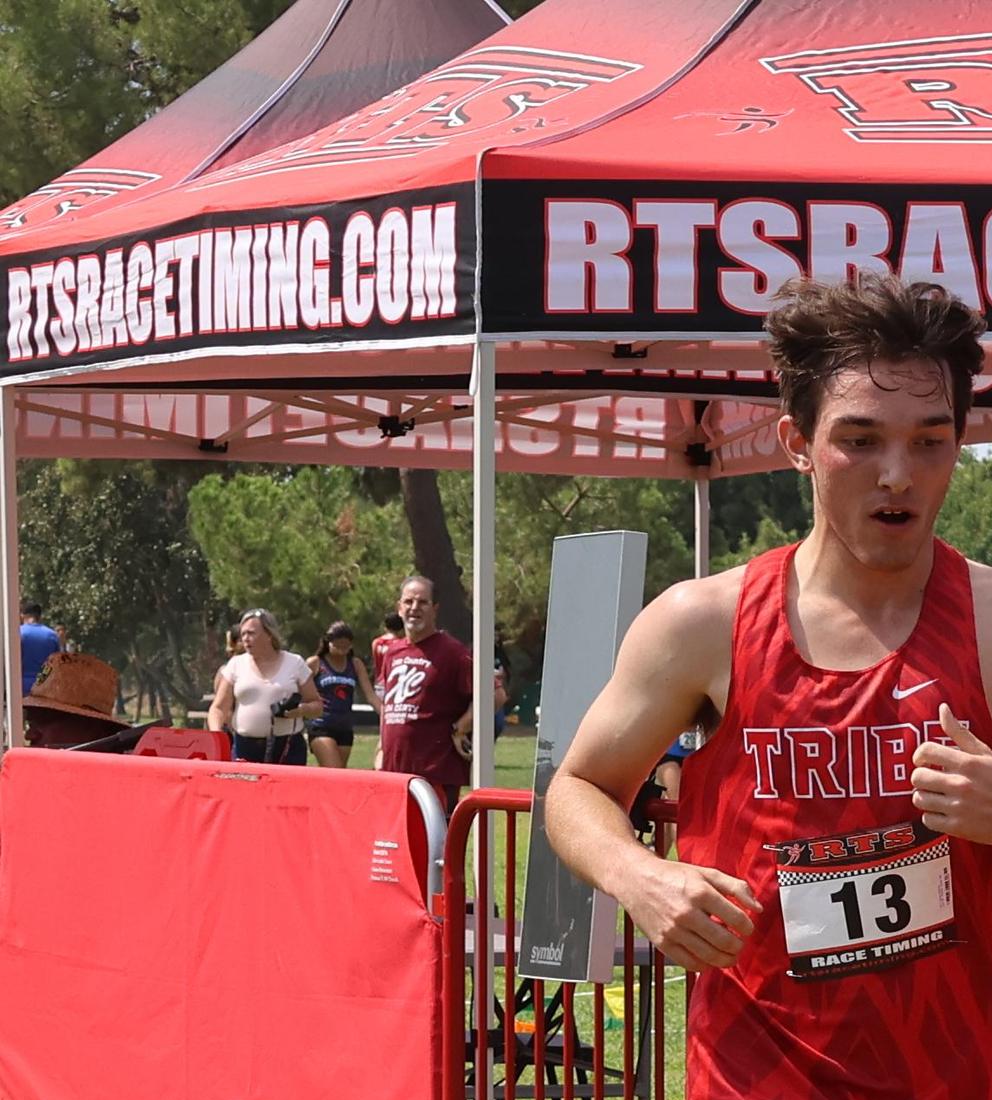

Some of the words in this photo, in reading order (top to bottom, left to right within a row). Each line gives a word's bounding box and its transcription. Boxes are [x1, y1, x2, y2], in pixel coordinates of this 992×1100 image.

[7, 202, 457, 362] RTSRACETIMING.COM
[743, 721, 970, 799] TRIB
[809, 827, 915, 862] RTS
[830, 873, 911, 940] 13
[531, 942, 564, 961] symbol
[810, 949, 867, 968] RACE
[870, 930, 943, 957] TIMING
